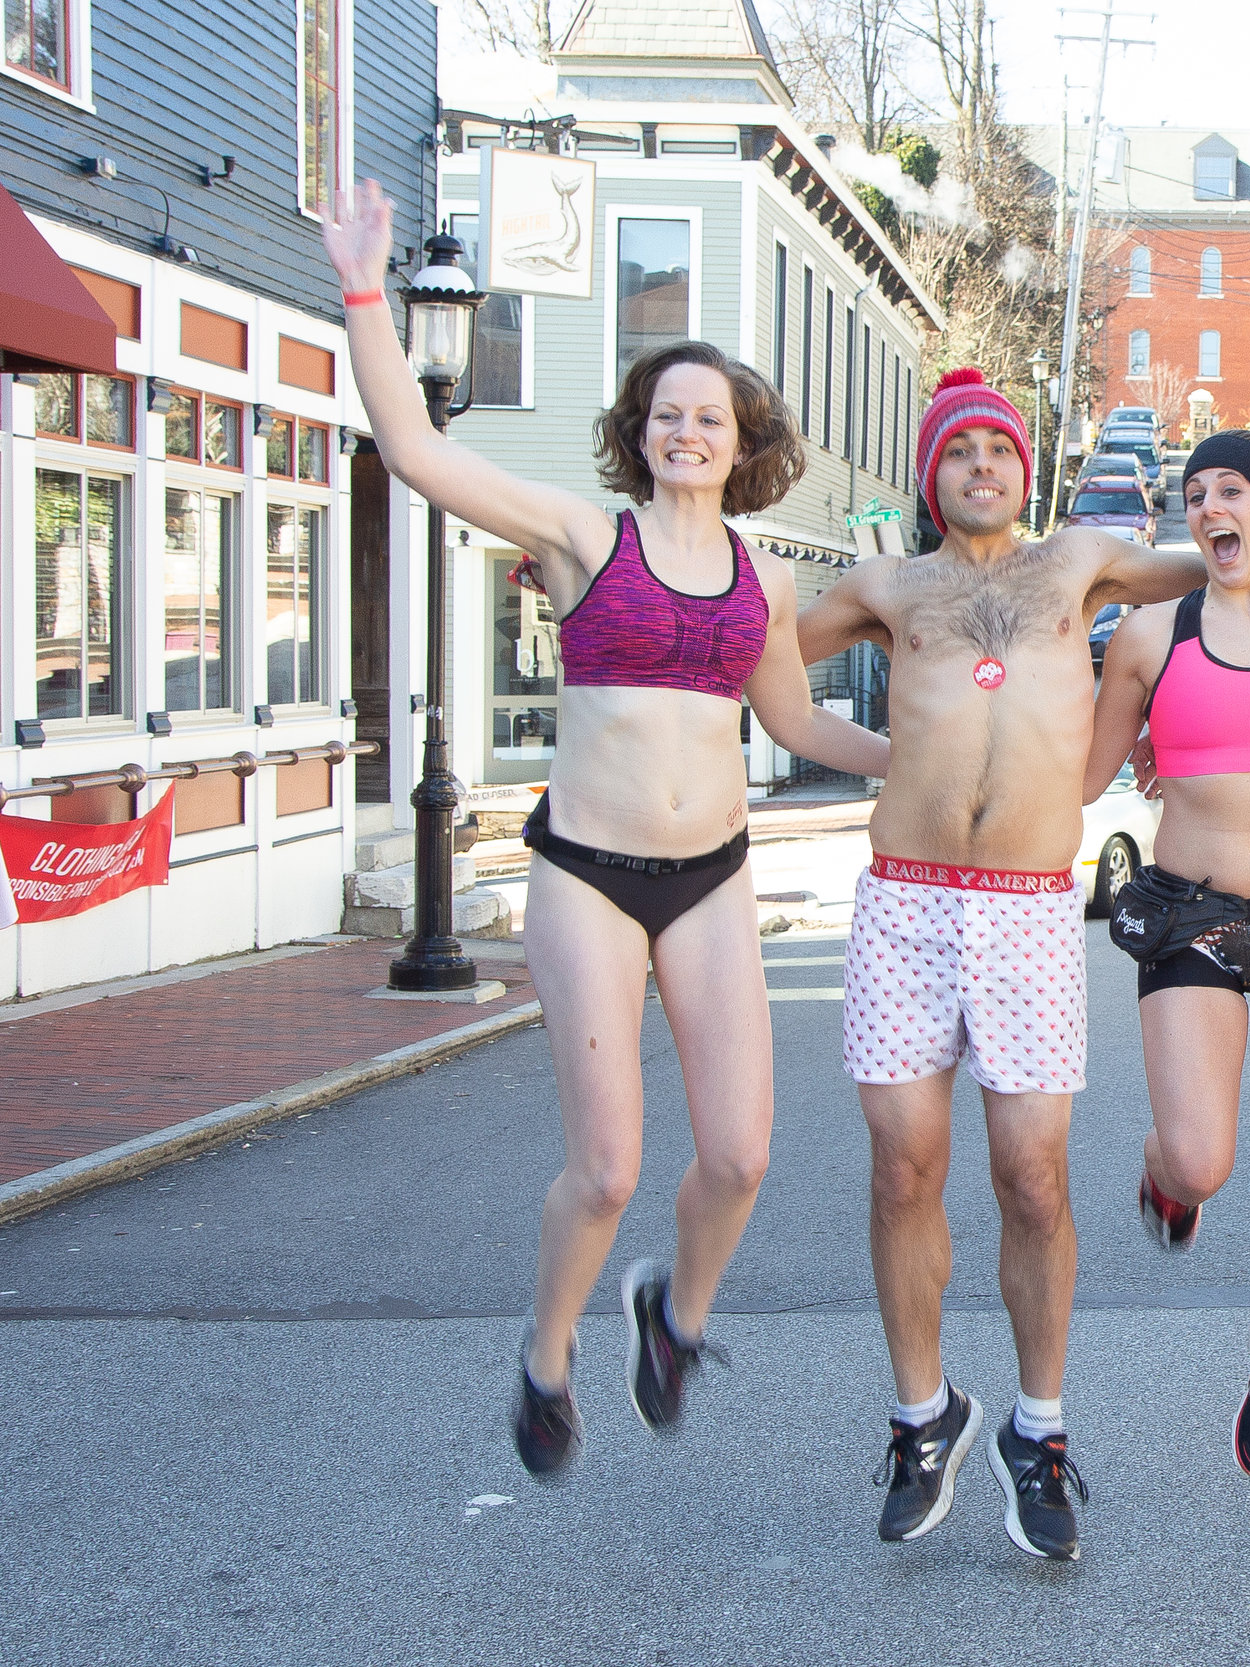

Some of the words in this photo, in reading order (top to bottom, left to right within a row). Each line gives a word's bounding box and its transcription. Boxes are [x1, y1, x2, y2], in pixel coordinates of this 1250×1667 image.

[30, 841, 122, 876] CLOTHING
[9, 878, 72, 902] SPONSIBLE
[886, 861, 949, 883] EAGLE
[977, 873, 1073, 892] AMERICAN
